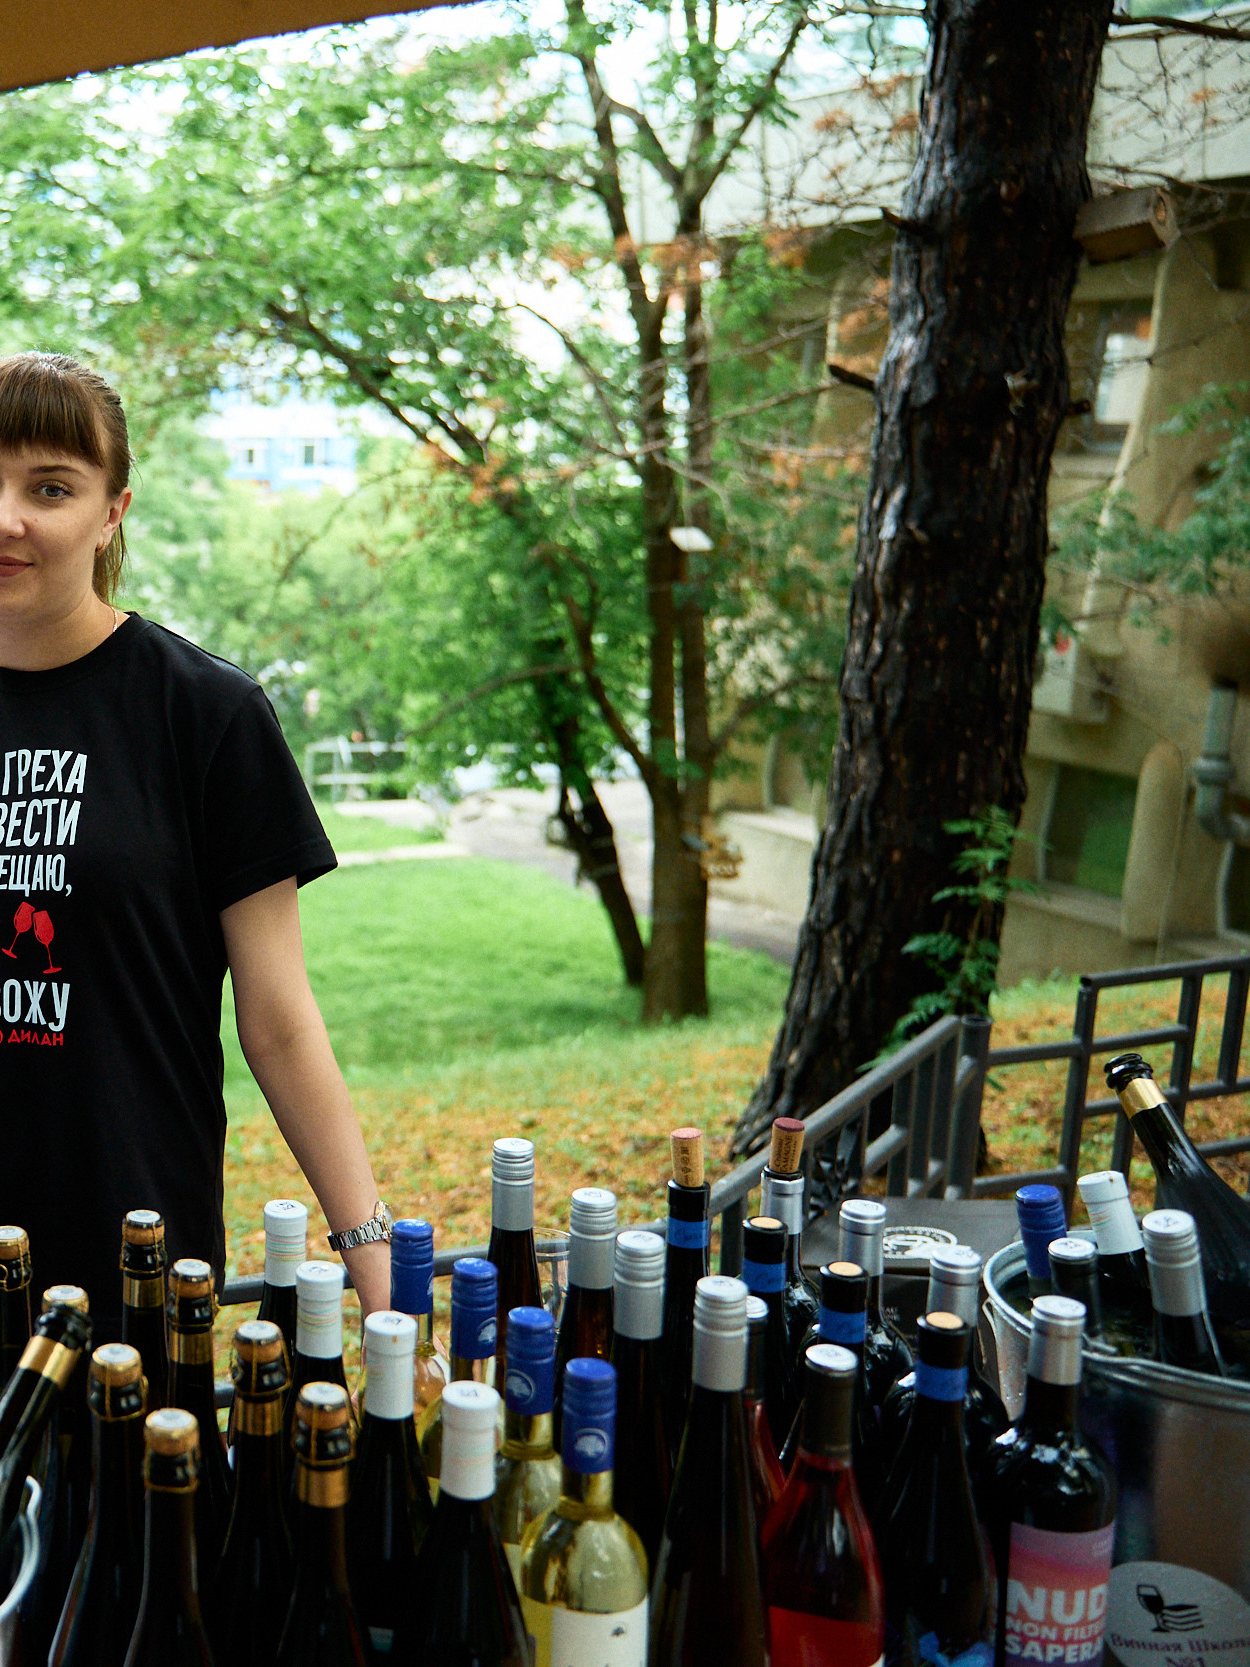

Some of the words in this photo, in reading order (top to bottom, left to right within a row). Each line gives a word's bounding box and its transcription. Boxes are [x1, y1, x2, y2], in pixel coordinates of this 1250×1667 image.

[1, 748, 88, 796] ГРЕХА
[7, 1032, 64, 1047] ДИЛАН
[1005, 1615, 1058, 1641] NON
[1110, 1632, 1183, 1652] Винная
